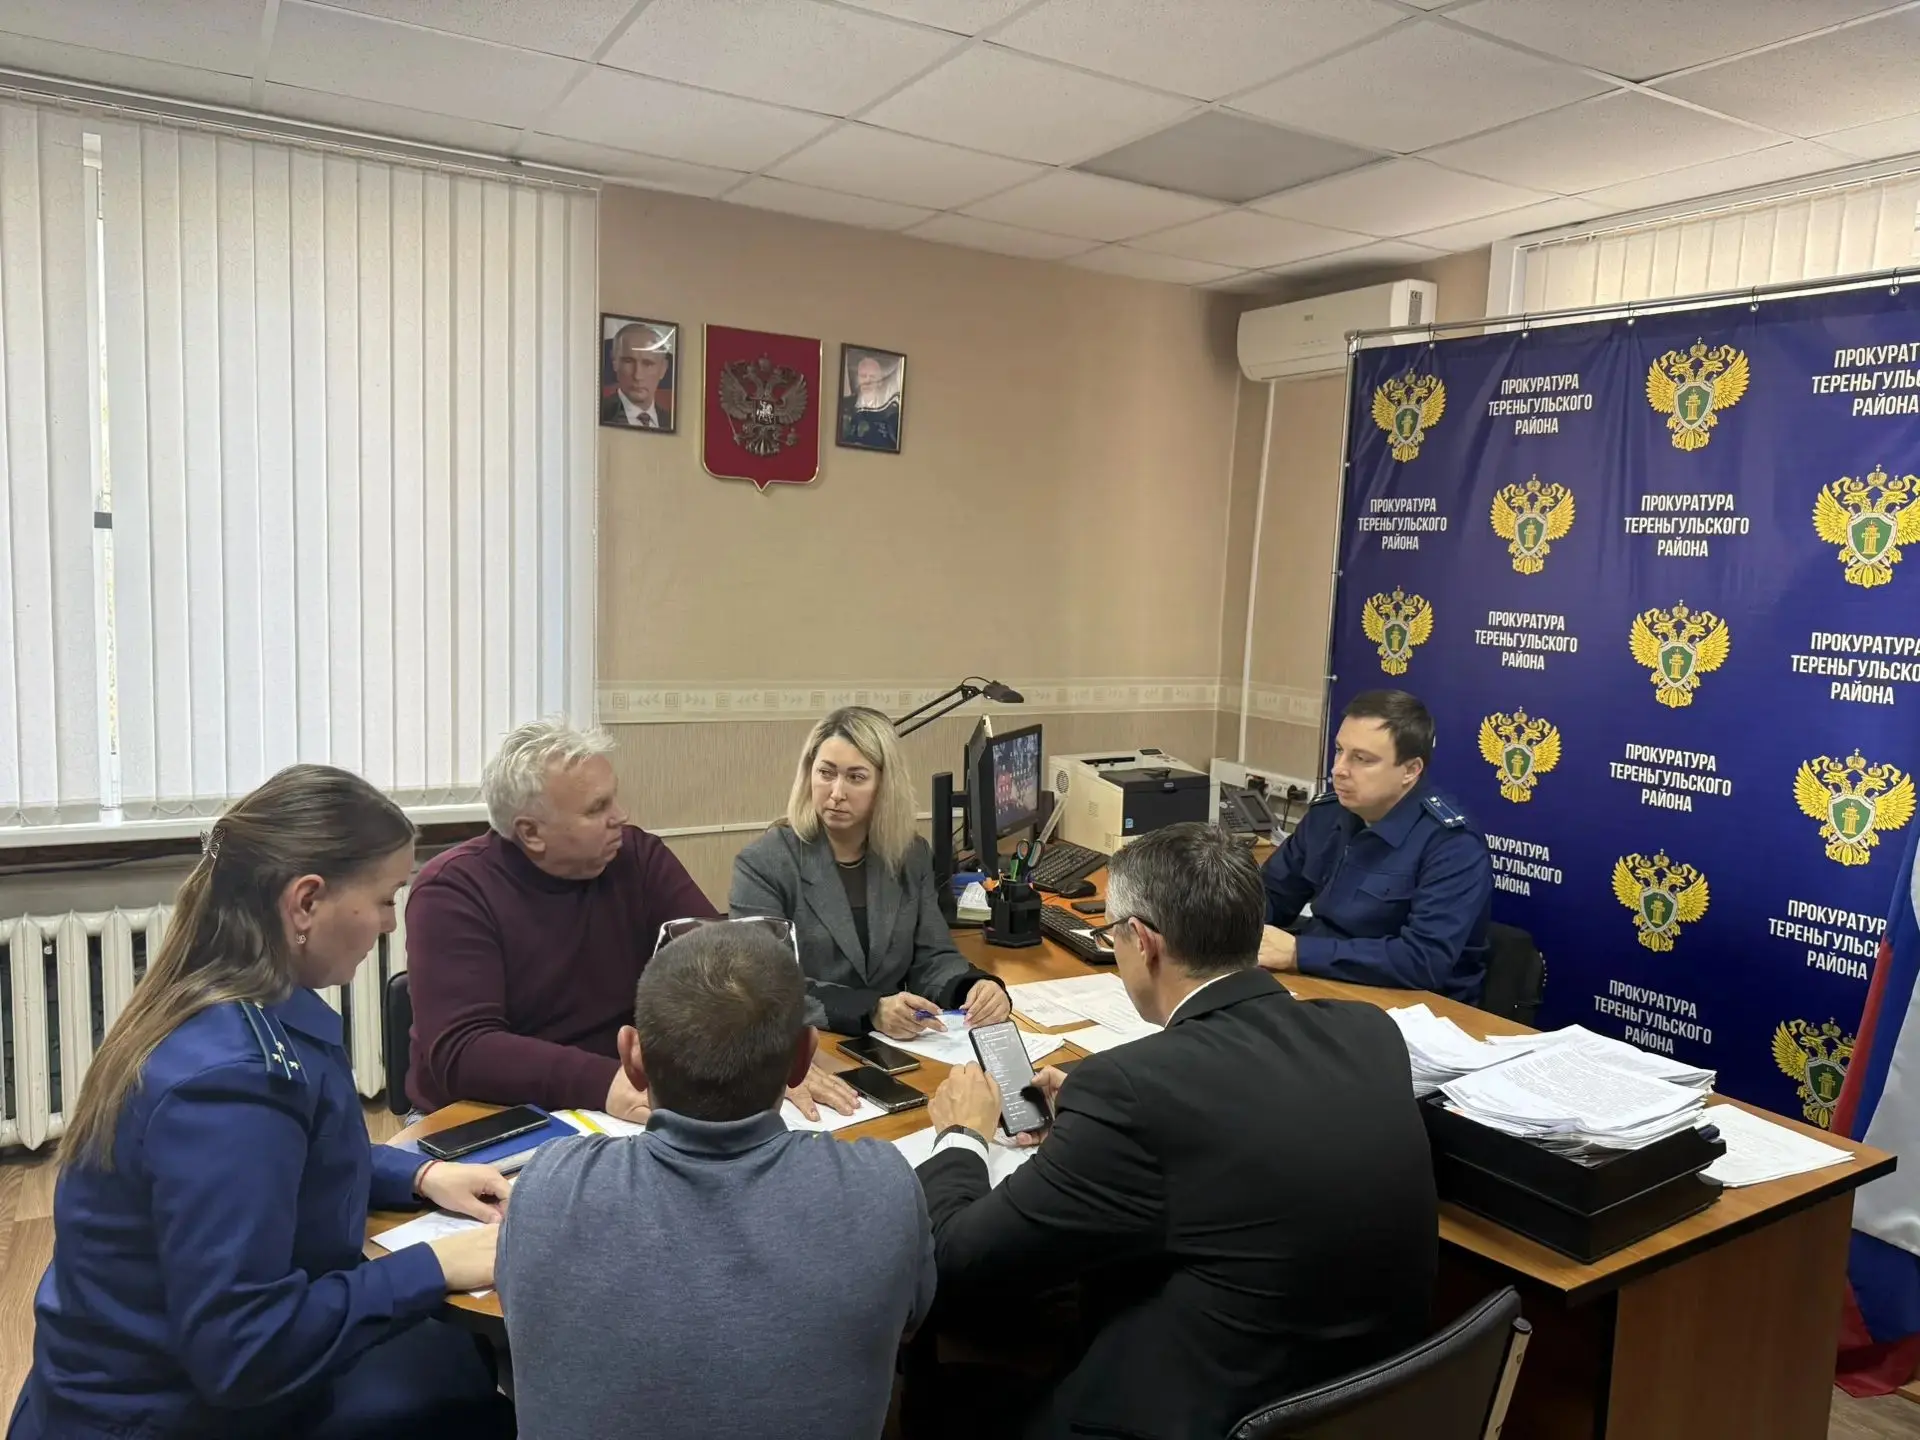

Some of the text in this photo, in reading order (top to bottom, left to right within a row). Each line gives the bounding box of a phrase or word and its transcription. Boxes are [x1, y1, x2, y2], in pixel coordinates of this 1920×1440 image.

[1834, 343, 1920, 368] ПРОКУРАТ
[1500, 374, 1579, 395] ПРОКУРАТУРА
[1488, 393, 1593, 417] ТЕРЕНЬГУЛЬСКОГО
[1852, 393, 1919, 417] РАЙОНА
[1515, 415, 1559, 435] РАЙОНА
[1370, 497, 1437, 514] ПРОКУРАТУРА
[1641, 494, 1734, 512] ПРОКУРАТУРА
[1358, 515, 1448, 532] ТЕРЕНЬГУЛЬСКОГО
[1624, 515, 1749, 535] ТЕРЕНЬГУЛЬСКОГО
[1381, 533, 1419, 551] РАЙОНА
[1657, 537, 1709, 557] РАЙОНА
[1488, 611, 1565, 631] ПРОКУРАТУРА
[1475, 630, 1578, 653] ТЕРЕНЬГУЛЬСКОГО
[1501, 651, 1545, 670] РАЙОНА
[1830, 681, 1895, 705] РАЙОНА
[1625, 743, 1717, 771] ПРОКУРАТУРА
[1609, 762, 1732, 797] ТЕРЕНЬГУЛЬСКОГО
[1641, 787, 1692, 813] РАЙОНА
[1485, 834, 1550, 861] ОКУРАТУРА
[1491, 855, 1562, 884] ЬГУЛЬСКОГО
[1493, 874, 1530, 896] АЙОНА
[1806, 950, 1868, 981] РАЙОНА
[1609, 979, 1697, 1019] ПРОКУРАТУРА
[1593, 995, 1712, 1045] ТЕРЕНЬГУЛЬСКОГО
[1625, 1025, 1674, 1054] РАЙОНА
